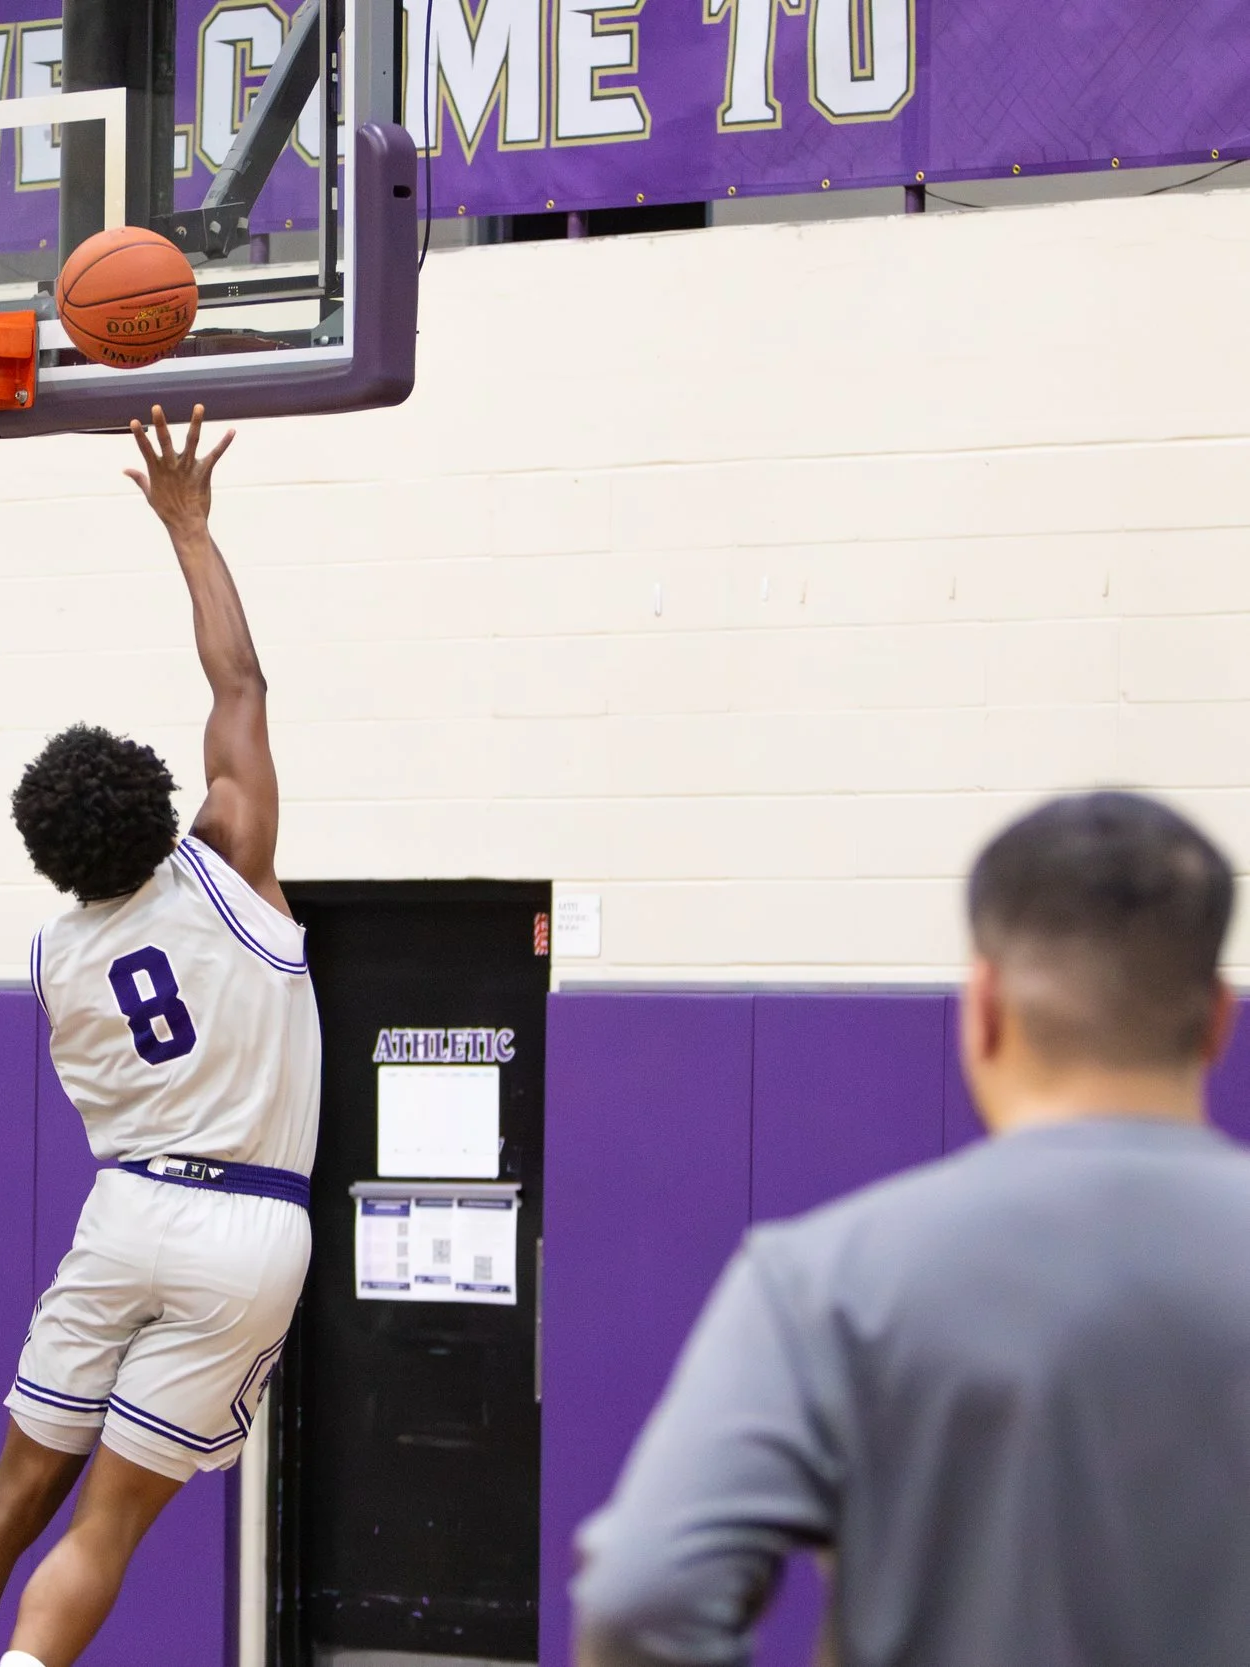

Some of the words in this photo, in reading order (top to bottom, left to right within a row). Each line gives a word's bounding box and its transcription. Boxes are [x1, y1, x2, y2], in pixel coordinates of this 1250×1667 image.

[702, 0, 915, 134] TO
[107, 945, 199, 1067] 8
[372, 1027, 516, 1063] ATHLETIC
